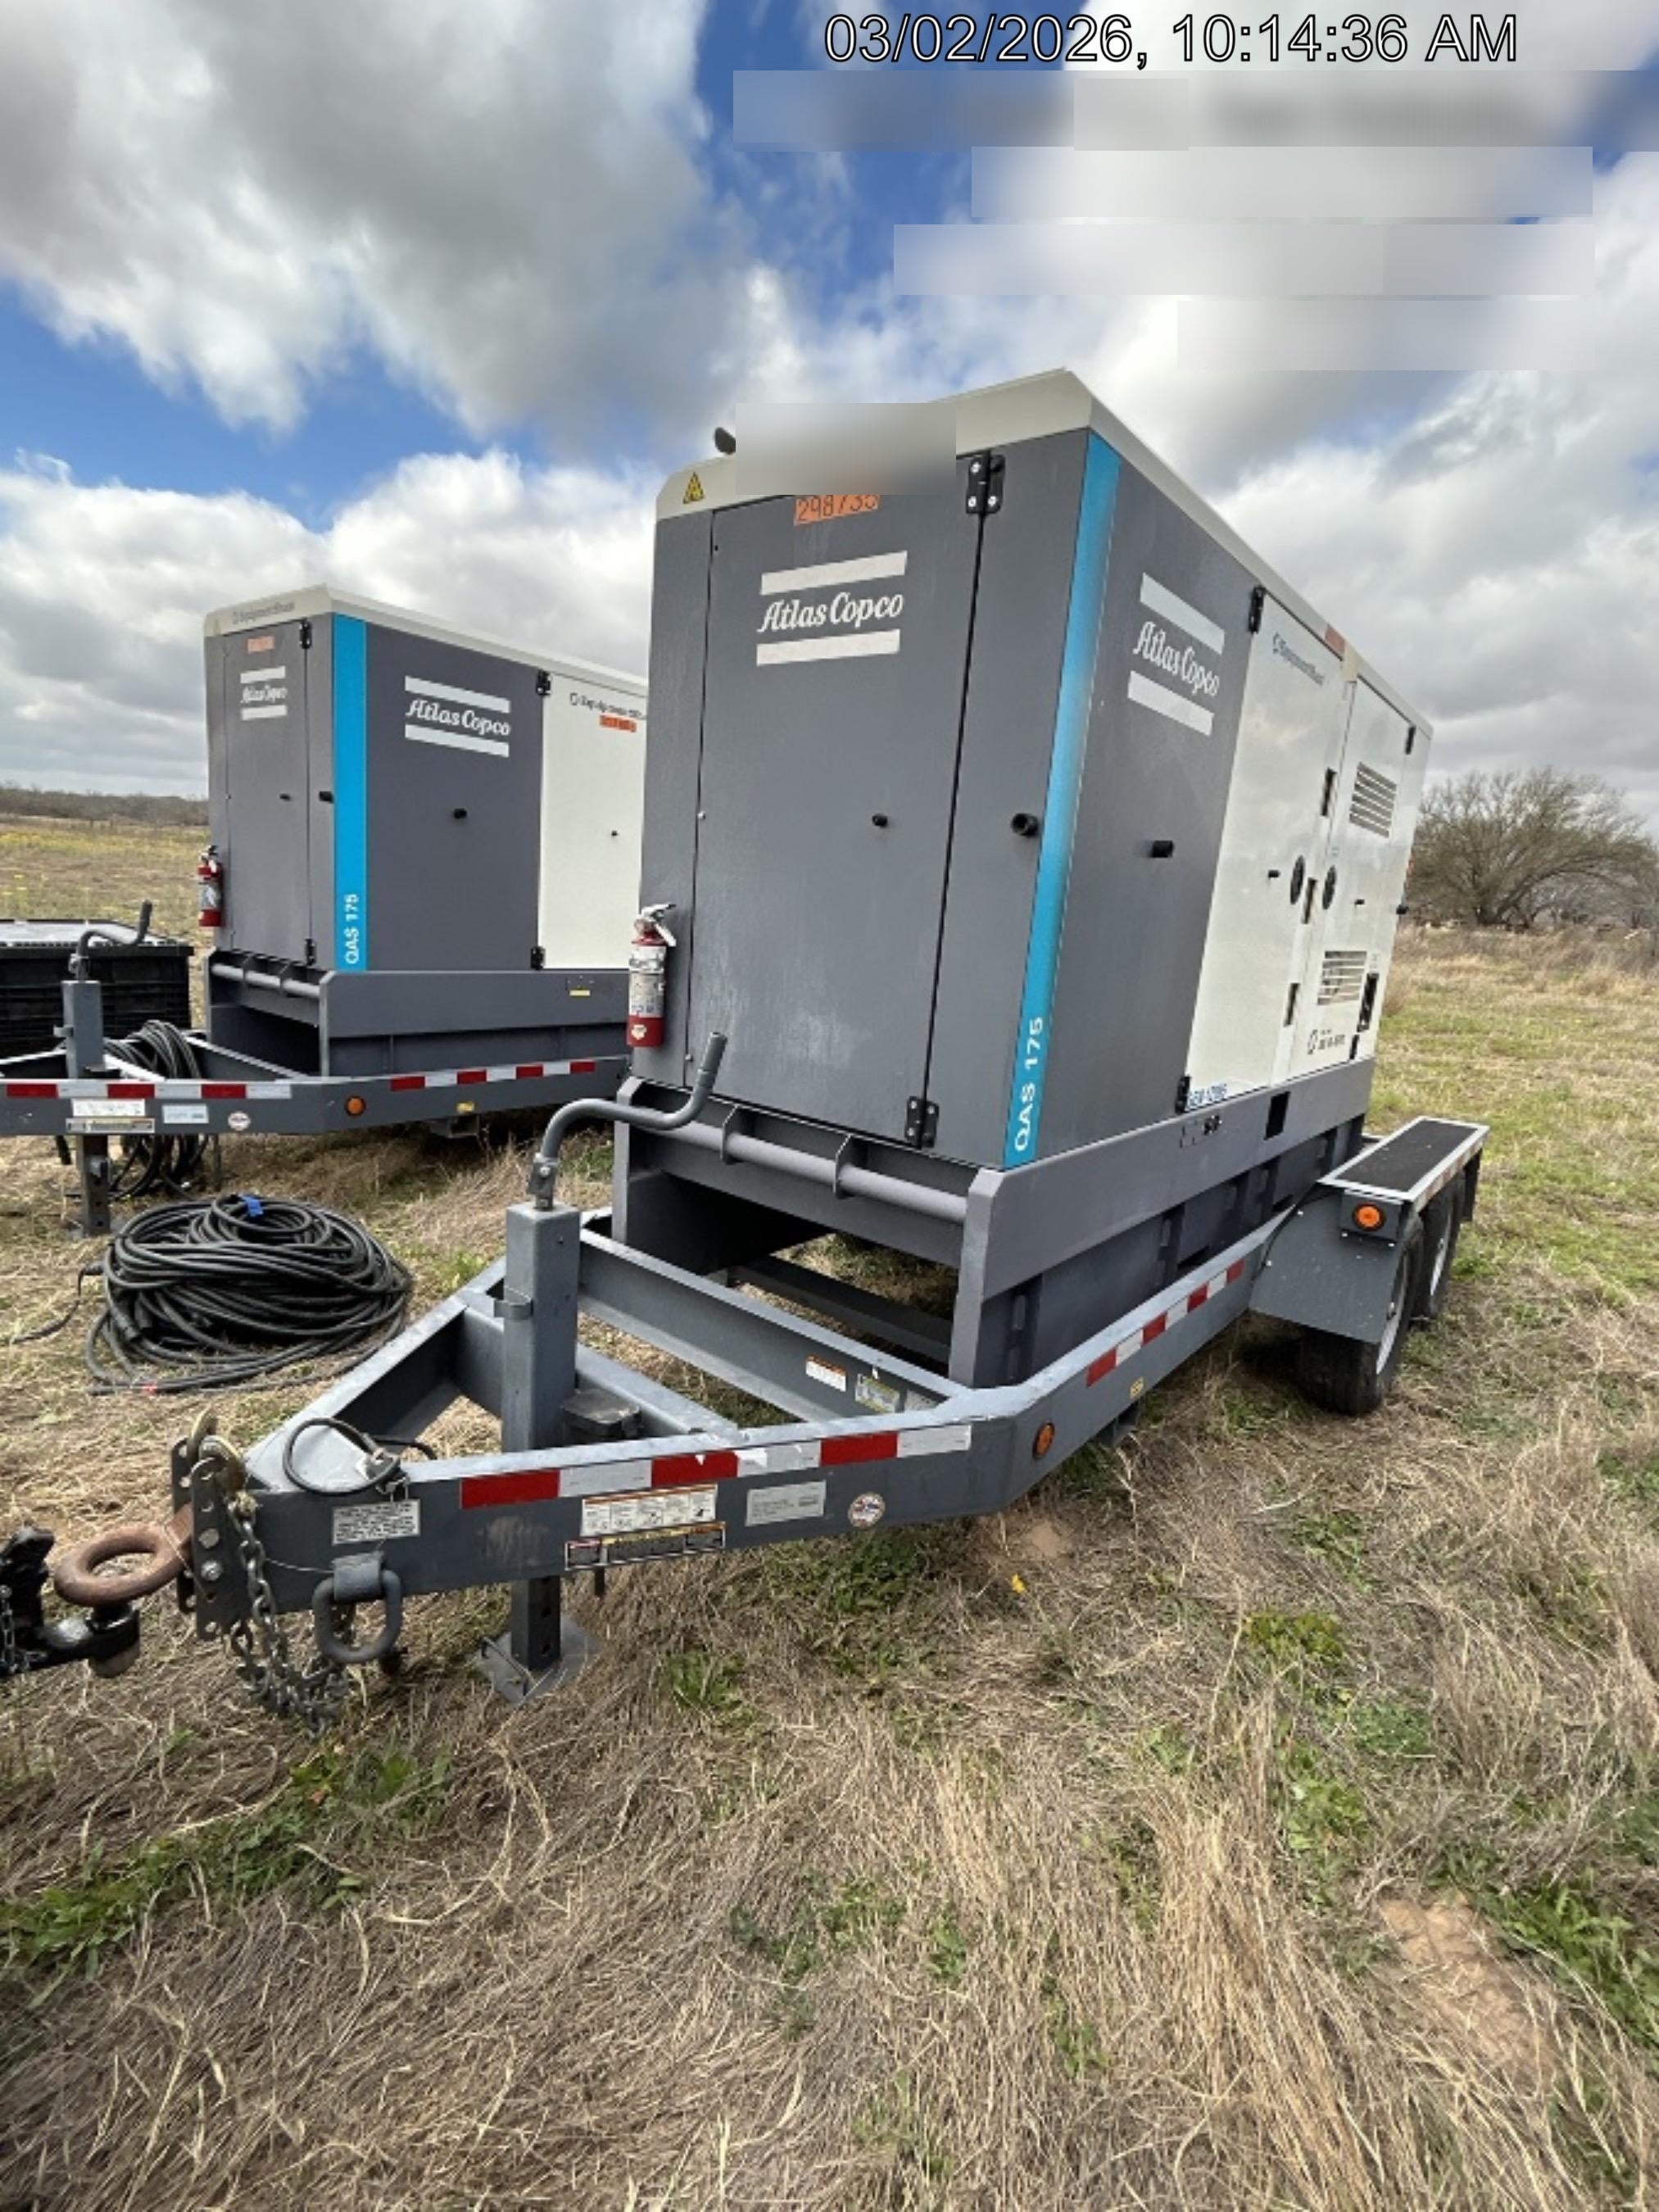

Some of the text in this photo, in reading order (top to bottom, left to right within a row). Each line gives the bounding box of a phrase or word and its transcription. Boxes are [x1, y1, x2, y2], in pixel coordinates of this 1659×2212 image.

[756, 592, 904, 633] Atlas Copco
[1132, 621, 1181, 676] Atlas
[1181, 646, 1221, 698] Copco
[405, 698, 511, 736] Atlas Copco
[343, 927, 360, 964] QAS
[1014, 1016, 1043, 1152] QAS 175
